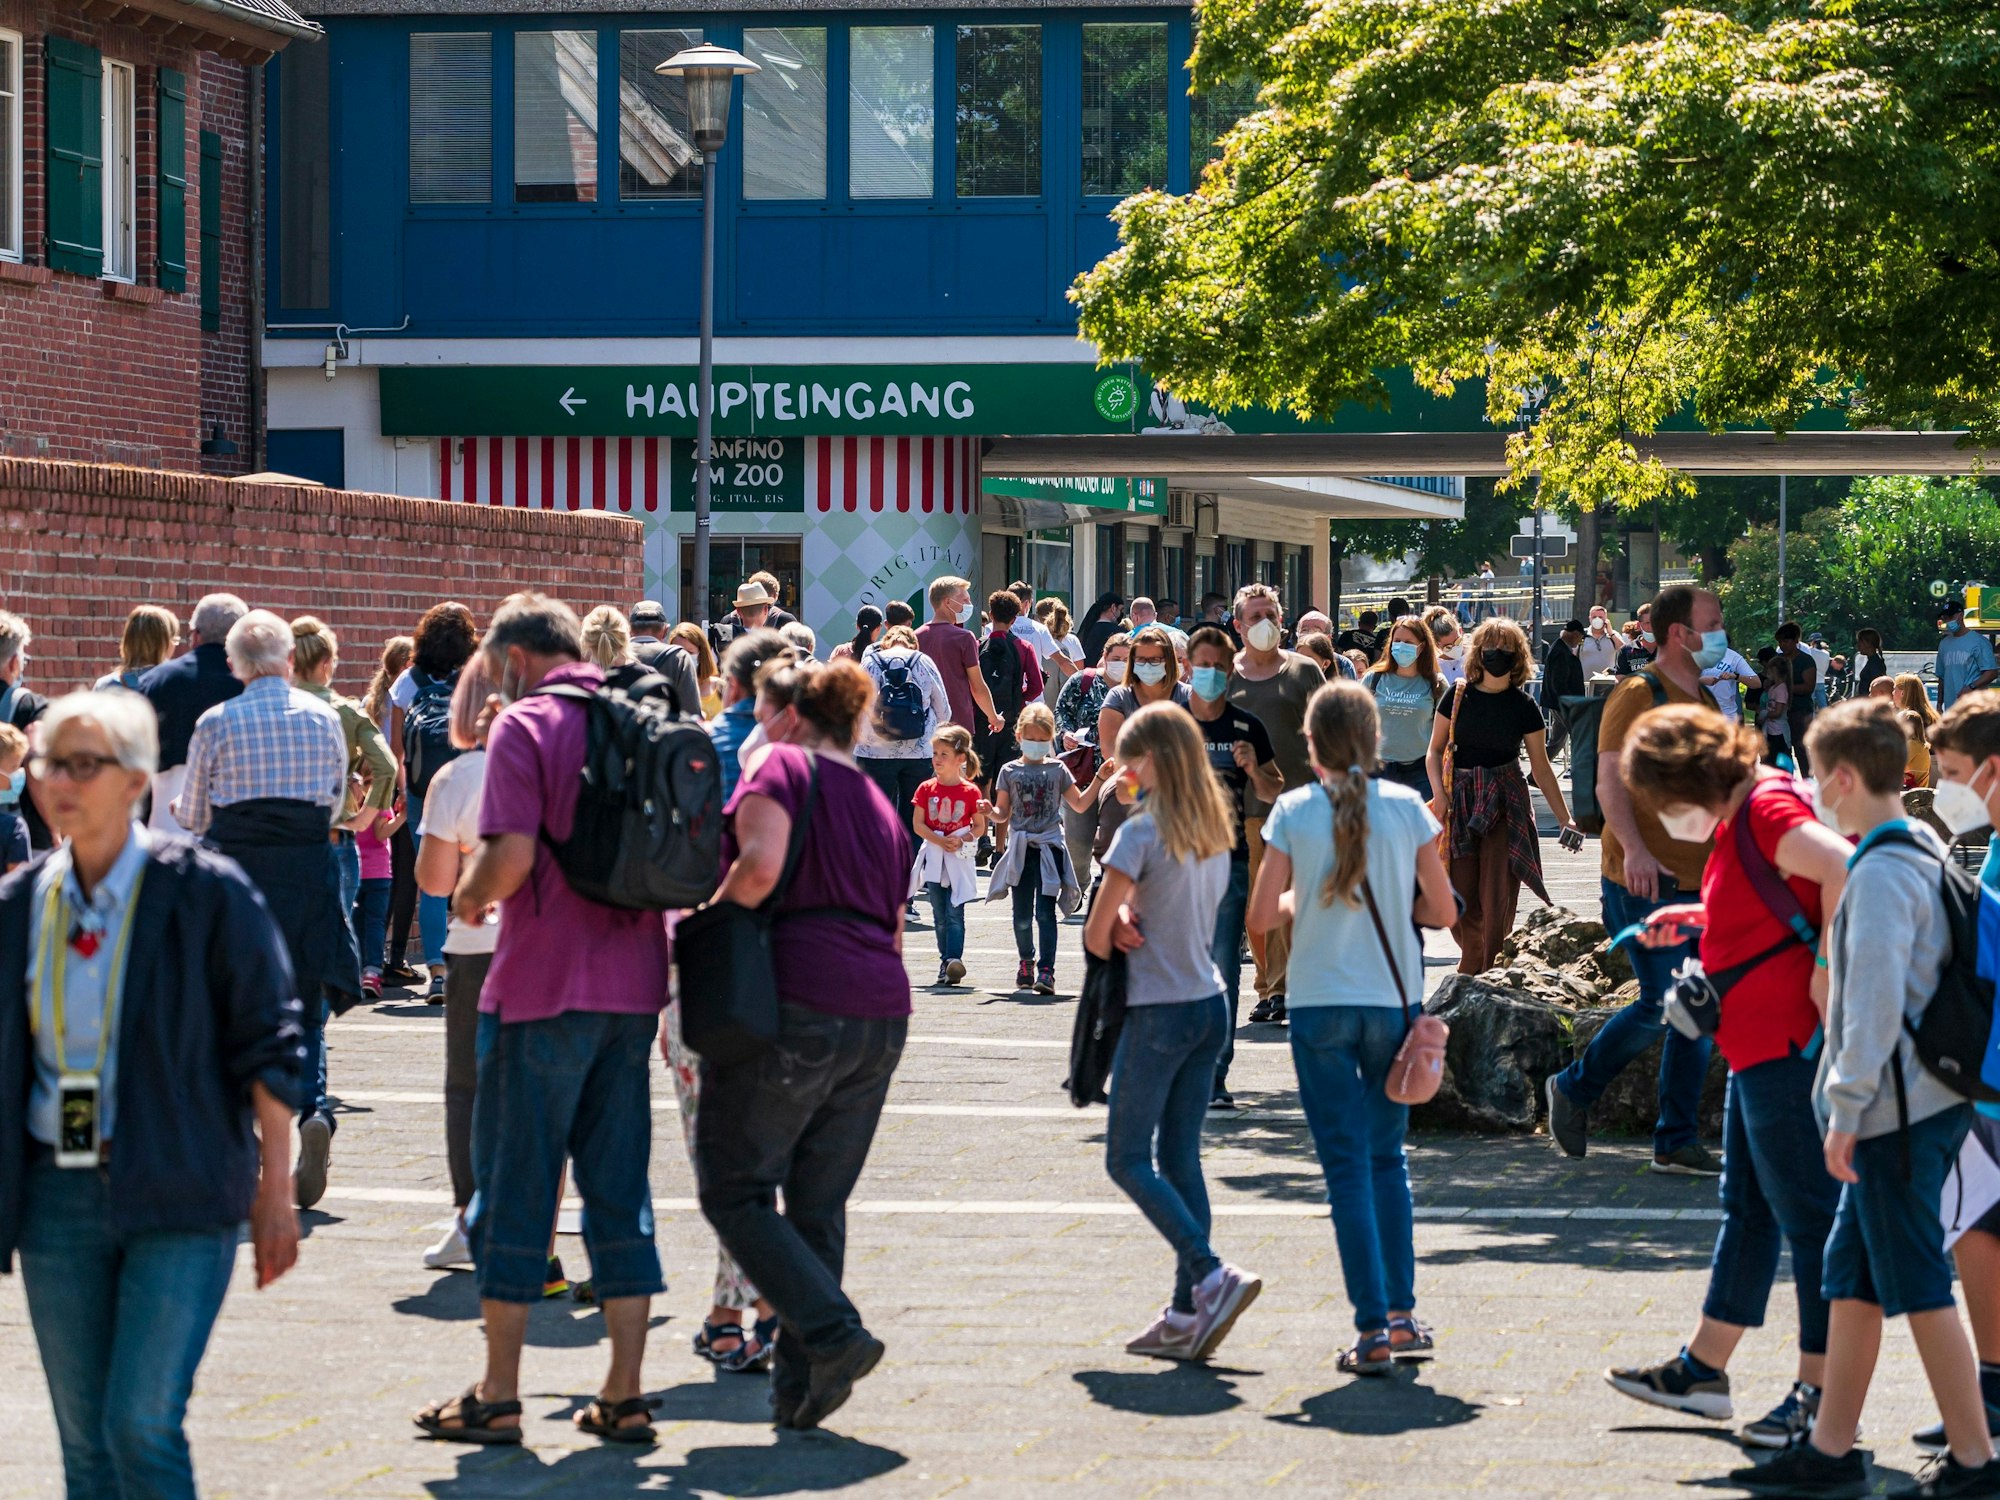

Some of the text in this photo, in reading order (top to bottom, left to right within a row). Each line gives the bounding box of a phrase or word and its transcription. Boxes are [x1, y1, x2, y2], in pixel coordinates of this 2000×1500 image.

[626, 381, 974, 420] HAUPTEINGANG
[733, 463, 784, 487] ZOO
[729, 494, 760, 503] ITAL.
[764, 494, 784, 503] EIS
[1934, 583, 1944, 595] H
[1385, 687, 1422, 700] Nothing
